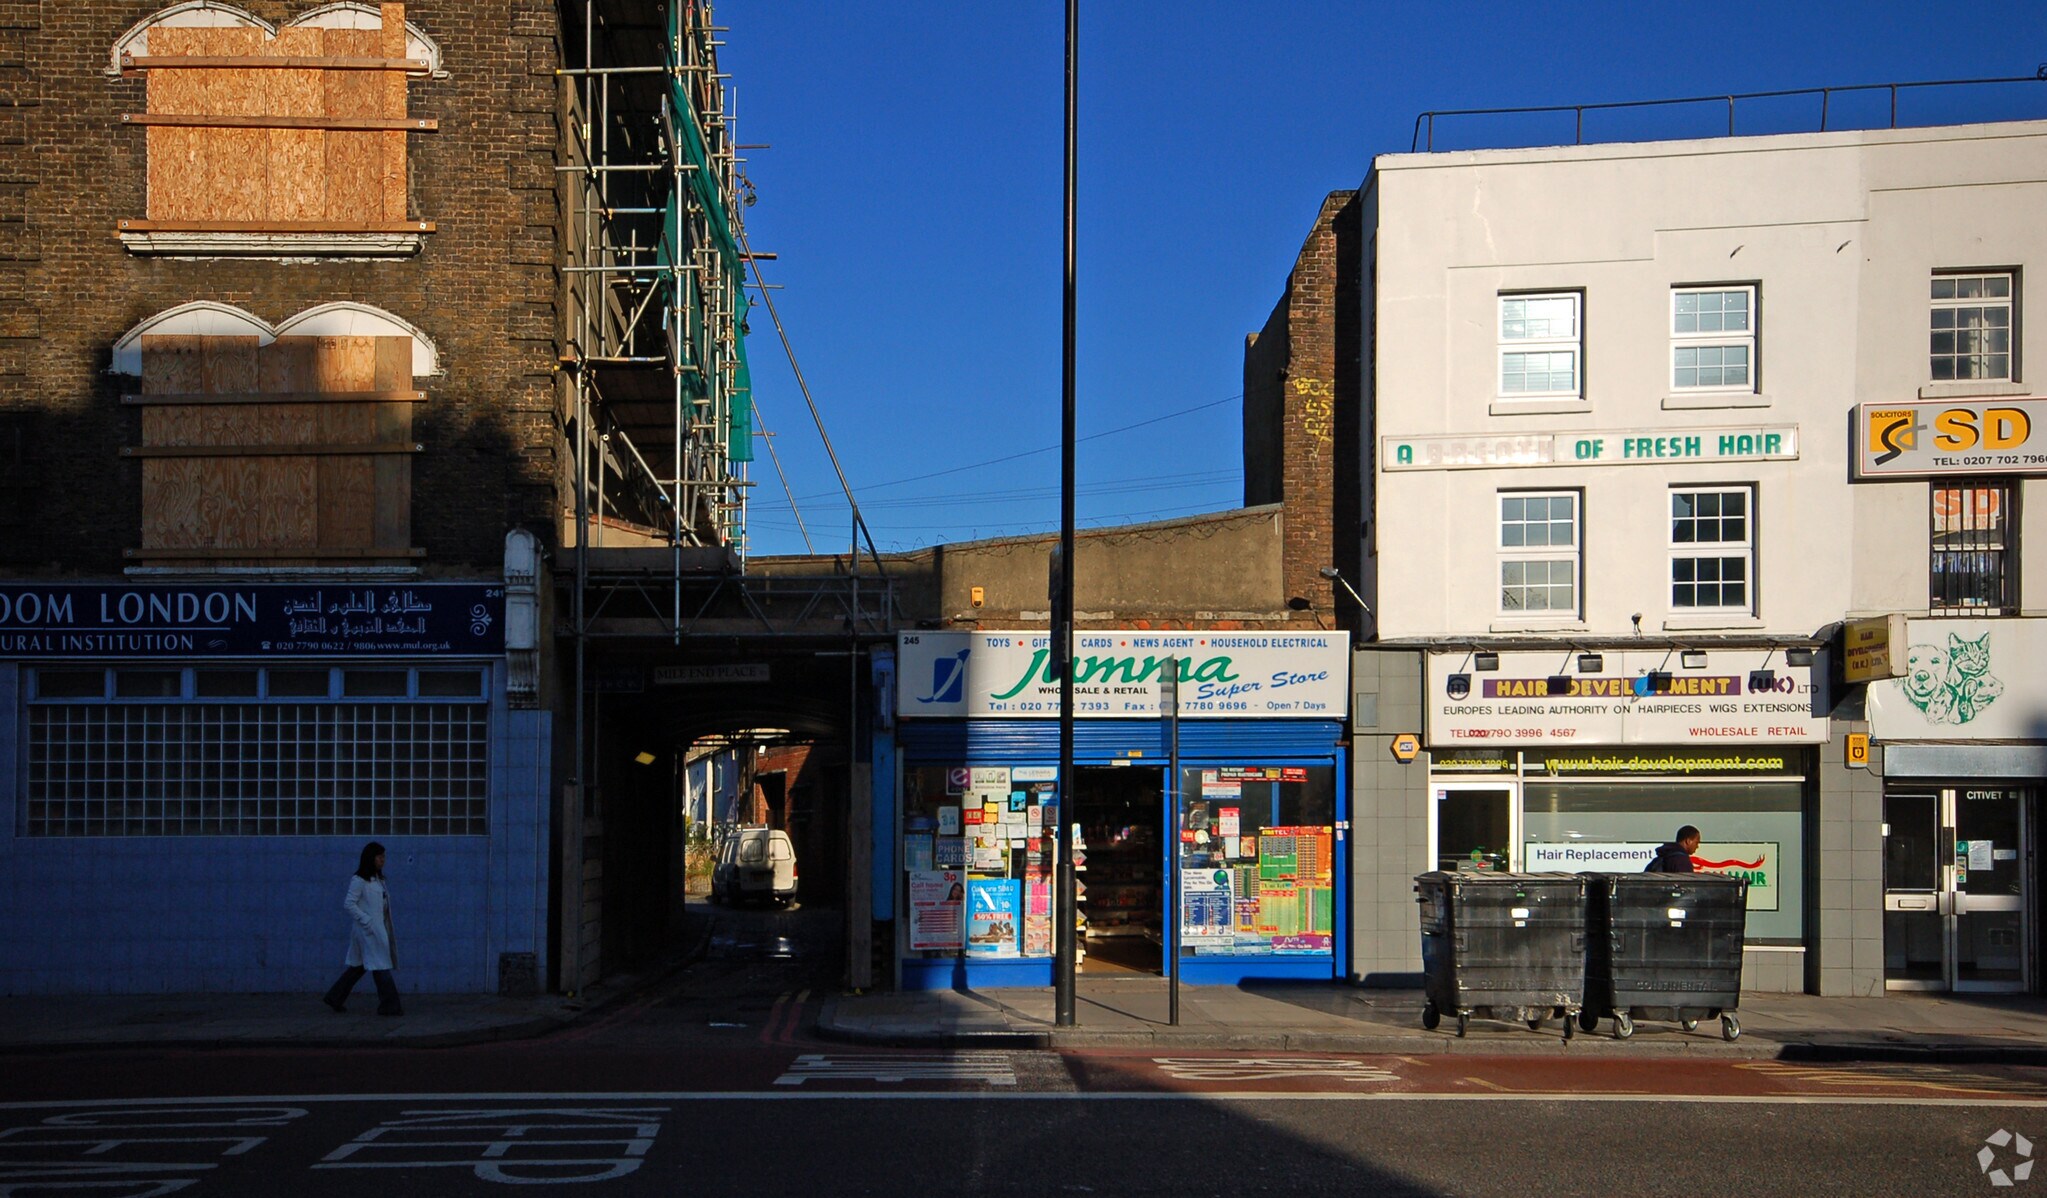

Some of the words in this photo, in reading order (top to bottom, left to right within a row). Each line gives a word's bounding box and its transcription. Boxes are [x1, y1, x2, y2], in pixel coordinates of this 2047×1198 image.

[1870, 411, 1912, 419] SOLICITORS
[1933, 407, 2032, 452] SD
[1397, 444, 1413, 465] A
[1575, 439, 1604, 460] OF
[1624, 436, 1701, 459] FRESH
[1719, 433, 1782, 456] HAIR
[1933, 457, 1960, 466] TEL:
[1963, 456, 1993, 465] 0207
[1997, 455, 2019, 464] 702
[2023, 454, 2047, 464] 796
[485, 588, 504, 598] 241
[100, 591, 257, 624] LONDON
[62, 633, 194, 651] INSTITUTION
[904, 636, 920, 645] 245
[986, 638, 1010, 648] TOYS
[1032, 638, 1051, 648] GIF
[1081, 638, 1112, 648] CARDS
[1133, 638, 1159, 648] NEWS
[1162, 638, 1194, 648] AGENT
[1211, 638, 1268, 648] HOUSEHOLD
[1271, 638, 1328, 648] ELECTRICAL
[276, 641, 294, 650] 020
[296, 641, 319, 650] 7790
[321, 641, 344, 650] 0622
[353, 641, 376, 650] 9806
[376, 640, 451, 653] www.mul.org.uk
[657, 669, 685, 680] MILE
[689, 668, 715, 679] END
[718, 667, 756, 678] PLACE
[1197, 681, 1262, 700] Super
[1271, 670, 1329, 688] Store
[1496, 680, 1549, 697] HAIR
[1797, 684, 1819, 694] LTD
[1020, 702, 1042, 711] 020
[1080, 702, 1110, 711] 7393
[1185, 702, 1214, 711] 7780
[1218, 702, 1247, 711] 9696
[1267, 702, 1291, 712] Open
[1294, 702, 1300, 711] 7
[1303, 701, 1326, 712] Days
[1443, 706, 1492, 715] EUROPES
[1498, 706, 1545, 715] LEADING
[1549, 705, 1608, 715] AUTHORITY
[1613, 705, 1631, 714] ON
[1638, 705, 1702, 714] HAIRPIECES
[1709, 704, 1738, 713] WIGS
[1743, 703, 1813, 713] EXTENSIONS
[1514, 729, 1543, 737] 3996
[1550, 728, 1576, 737] 4567
[1689, 728, 1758, 736] WHOLESALE
[1768, 727, 1807, 736] RETAIL
[1401, 742, 1413, 751] ADT
[1439, 759, 1458, 769] 020
[1966, 791, 2003, 800] CITIVET
[937, 845, 971, 853] PHONE
[935, 853, 972, 862] CARDS
[1536, 848, 1563, 861] Hair
[1565, 848, 1653, 862] Replacement
[943, 872, 957, 882] 3p
[1636, 981, 1718, 991] CONTINENTAL
[1151, 1057, 1401, 1082] BUS
[310, 1107, 672, 1185] KEEP
